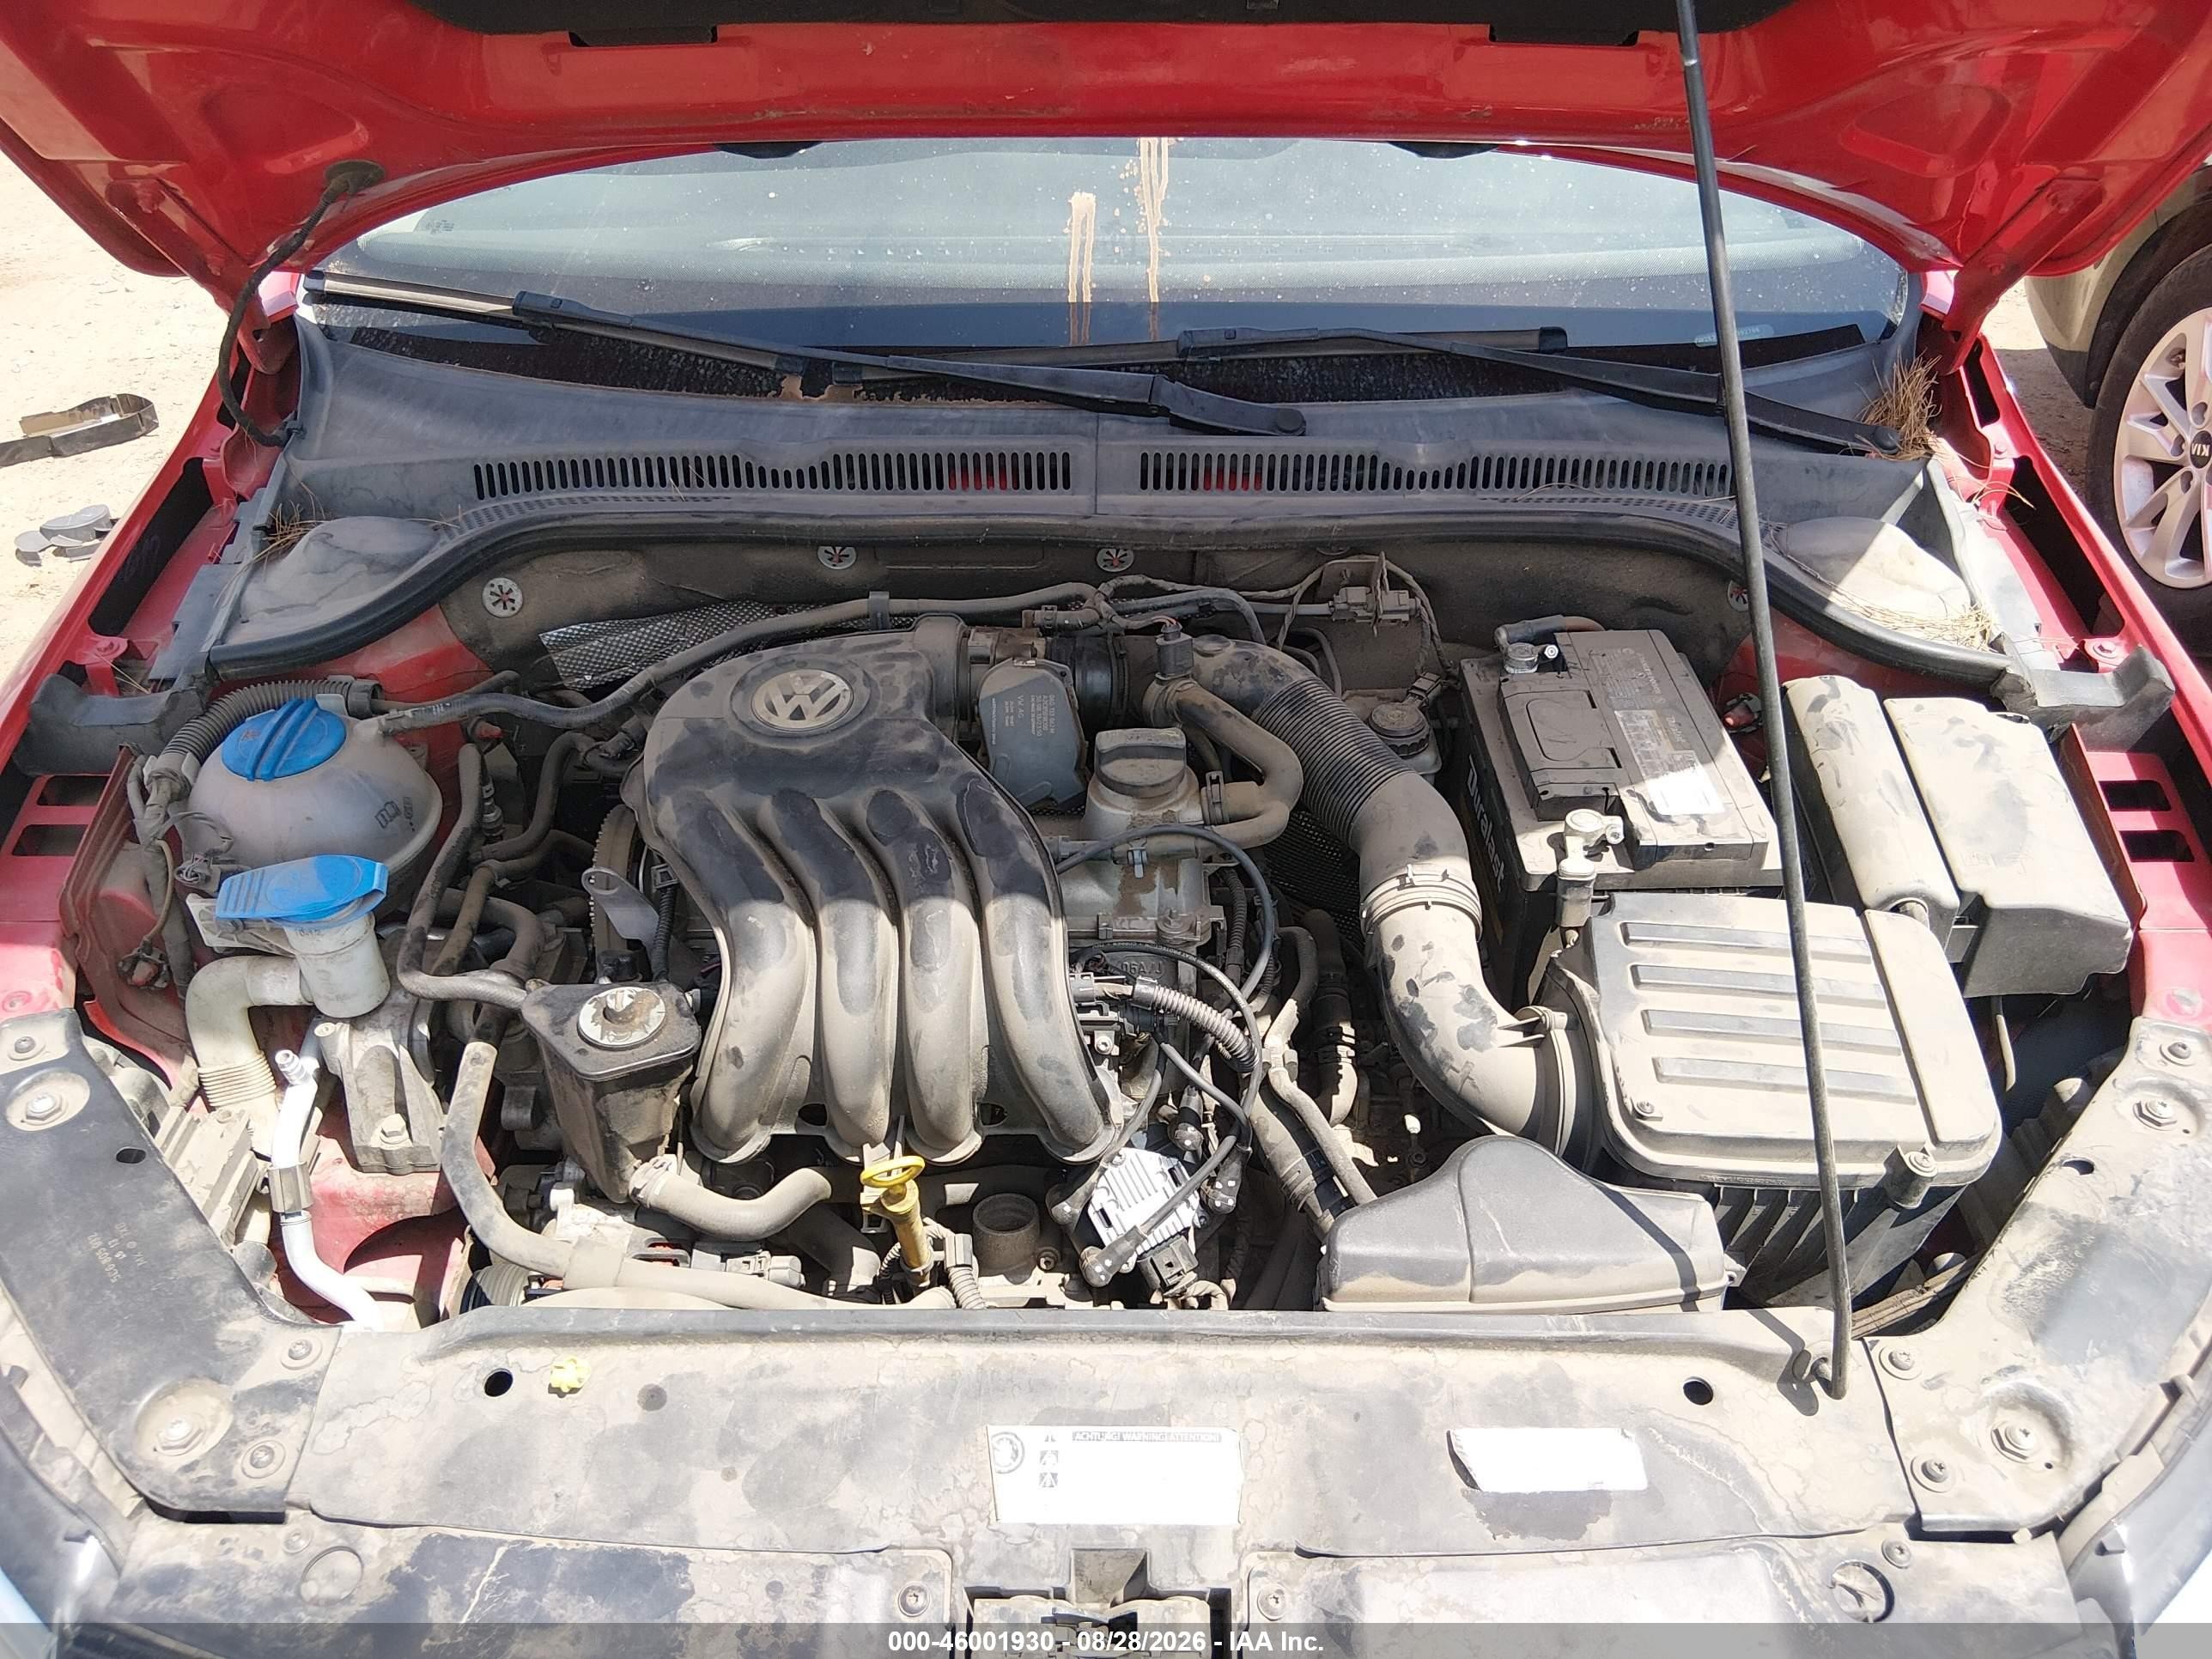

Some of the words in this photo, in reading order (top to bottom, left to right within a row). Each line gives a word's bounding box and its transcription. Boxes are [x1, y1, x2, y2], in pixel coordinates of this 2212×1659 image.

[2191, 443, 2210, 457] KIA
[1468, 754, 1504, 893] Duralast
[1145, 943, 1182, 957] PROTECTION
[1181, 951, 1198, 963] HEAT
